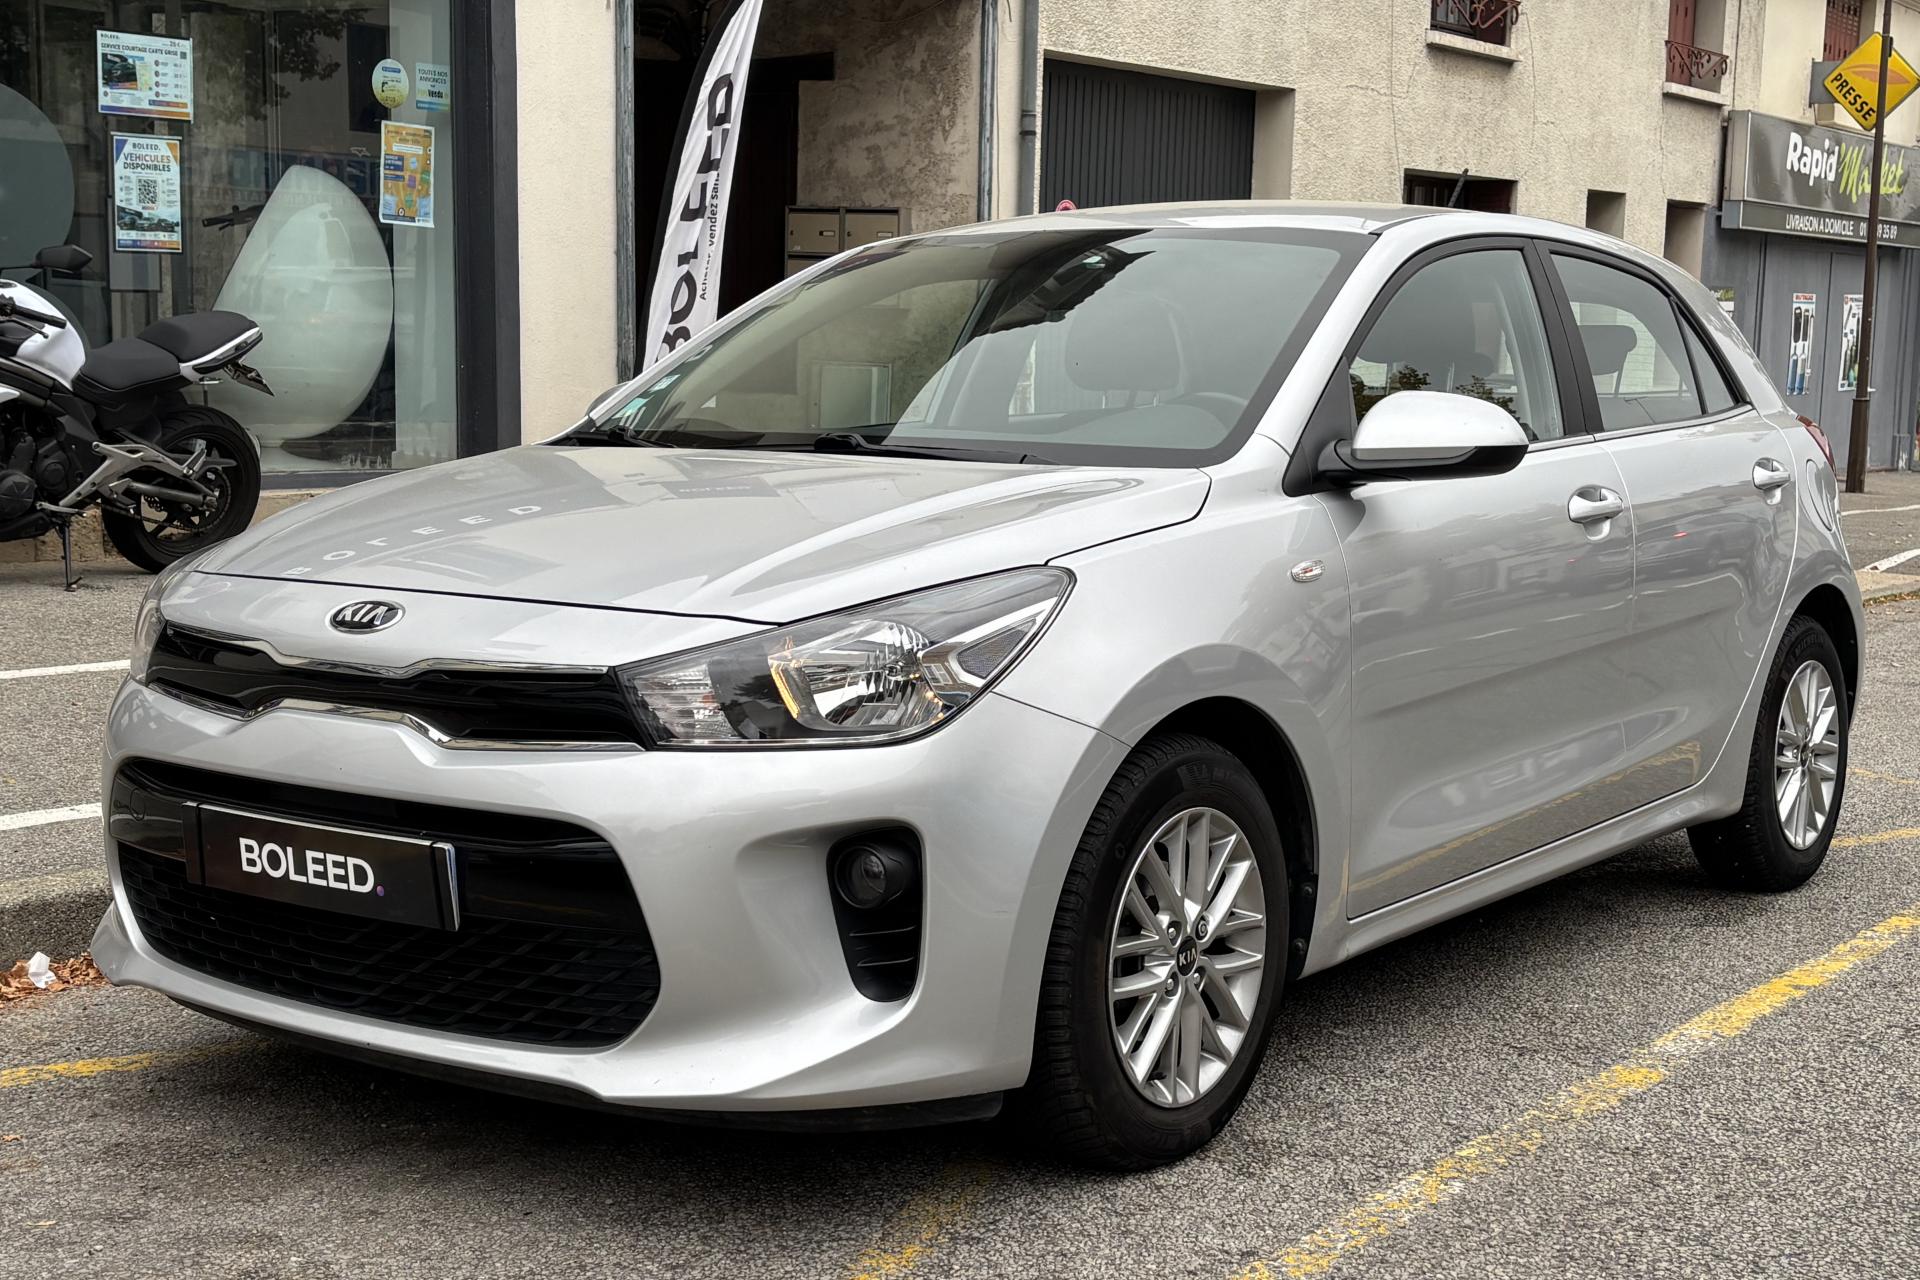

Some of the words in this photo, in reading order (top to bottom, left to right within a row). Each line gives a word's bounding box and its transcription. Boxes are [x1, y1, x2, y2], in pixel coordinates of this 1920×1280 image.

[101, 42, 121, 50] SERVICE
[122, 45, 147, 53] COURTAGE
[165, 49, 178, 57] GRISE
[1830, 72, 1876, 122] PRESSE
[123, 152, 171, 164] VEHICULES
[123, 162, 171, 172] DISPONIBLES
[1786, 132, 1840, 187] Rapid
[707, 203, 719, 247] vendez
[1785, 213, 1819, 233] LIVRAISON
[1818, 217, 1824, 233] A
[1824, 218, 1854, 236] DOMICILE
[1860, 222, 1867, 237] 01
[1883, 224, 1890, 239] 35
[336, 602, 388, 625] KIA
[1178, 949, 1197, 967] KIA
